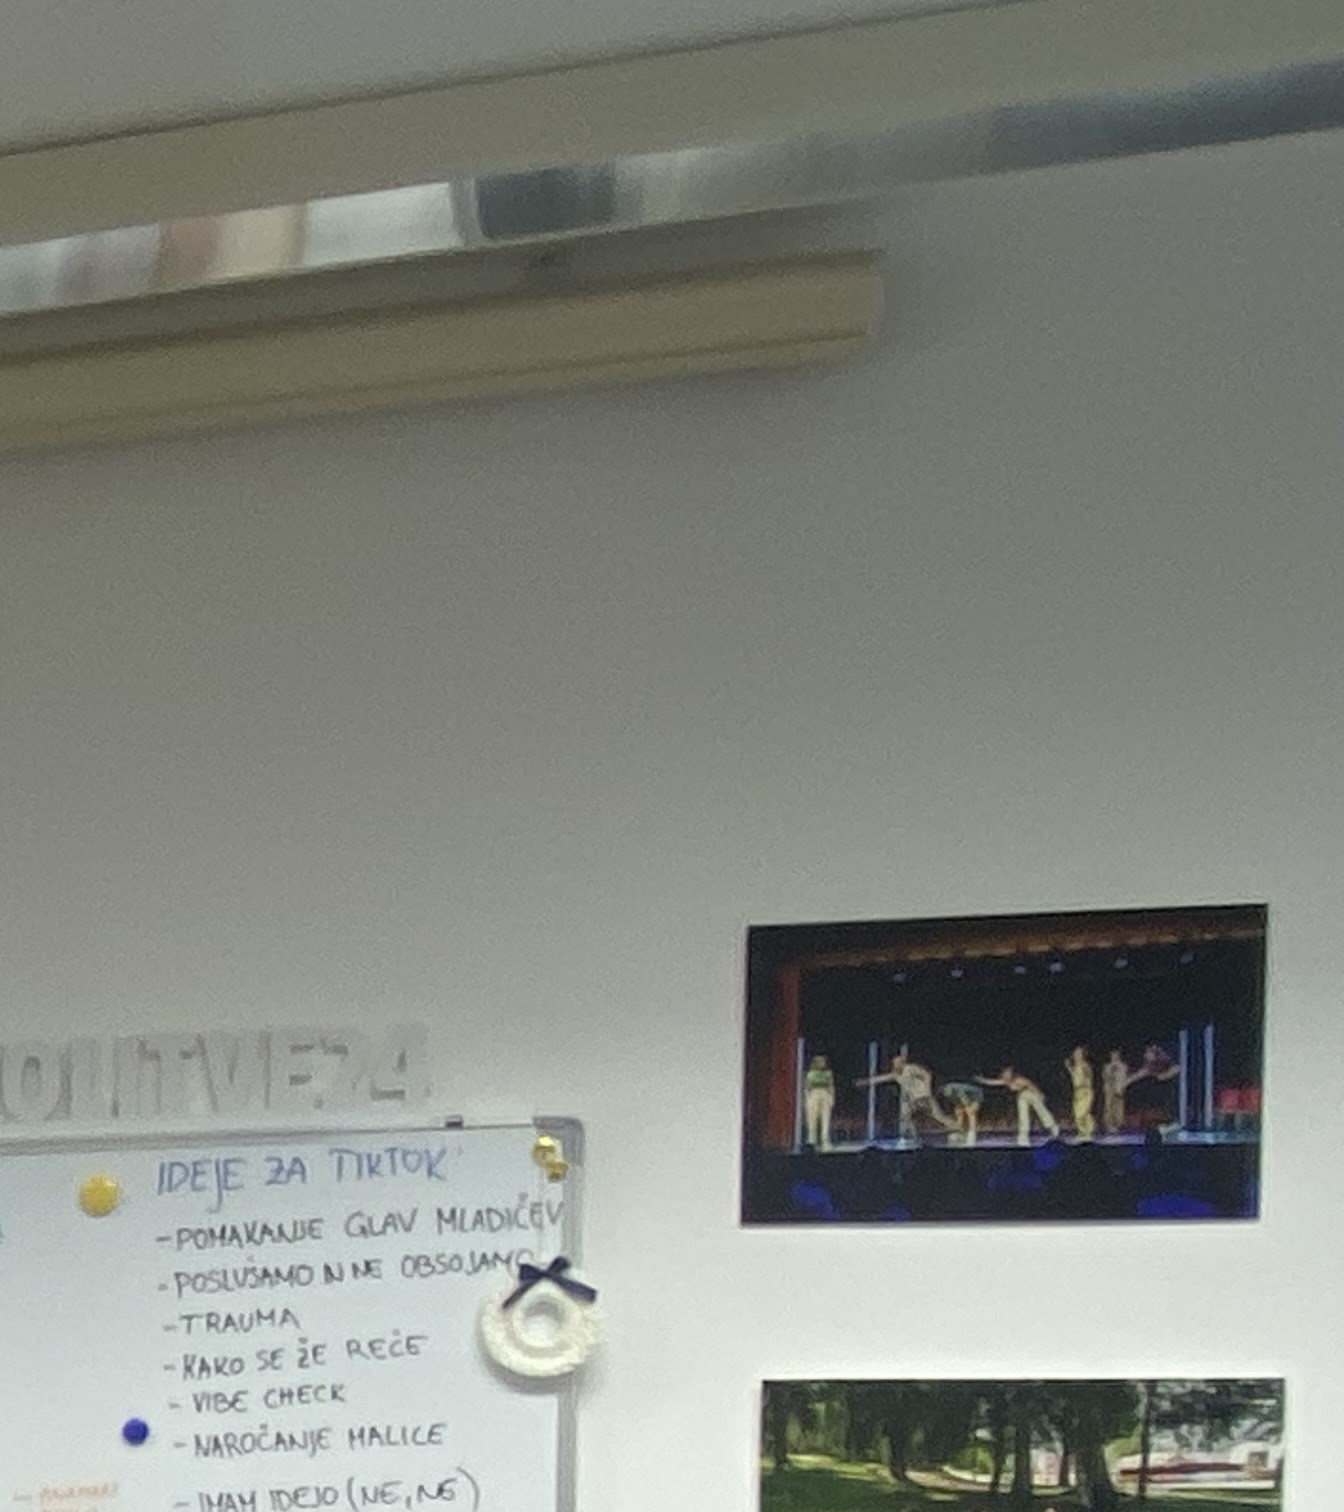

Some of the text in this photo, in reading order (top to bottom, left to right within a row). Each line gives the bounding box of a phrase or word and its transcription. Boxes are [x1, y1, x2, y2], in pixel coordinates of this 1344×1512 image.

[157, 1147, 448, 1212] IDEJE ZA TIKTOK
[344, 1207, 418, 1238] GLAV
[352, 1258, 383, 1280] NE
[256, 1348, 285, 1371] SE
[192, 1389, 248, 1416] VIBE
[263, 1383, 346, 1409] CHECK
[348, 1422, 448, 1449] MALICE
[270, 1486, 339, 1512] IDEJO
